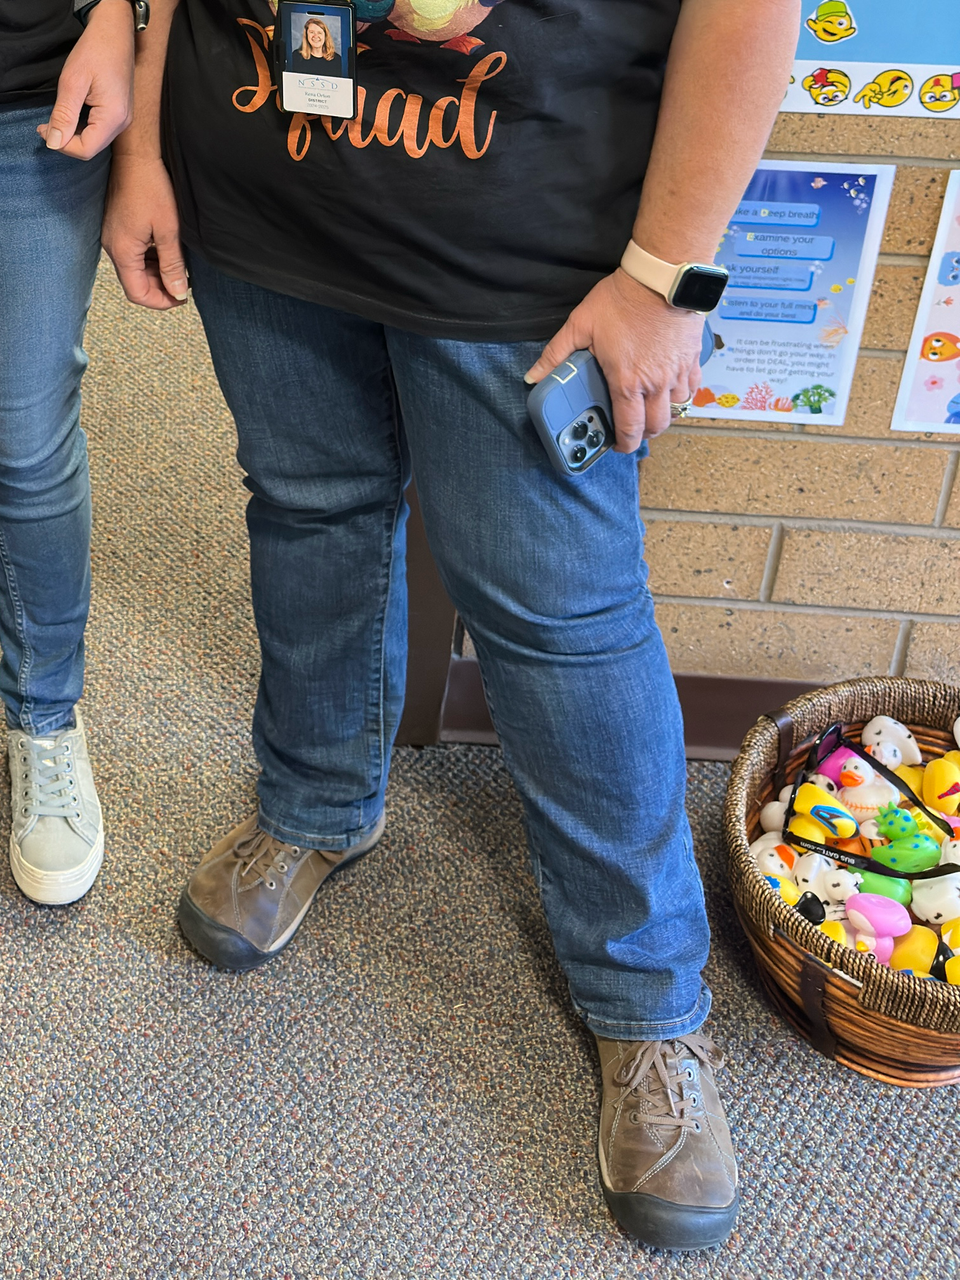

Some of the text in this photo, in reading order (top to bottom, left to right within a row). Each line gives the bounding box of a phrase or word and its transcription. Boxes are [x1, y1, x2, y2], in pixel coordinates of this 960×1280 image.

[760, 209, 785, 218] Deep
[747, 232, 815, 244] Examine your
[761, 248, 798, 256] options
[740, 266, 780, 274] yourself
